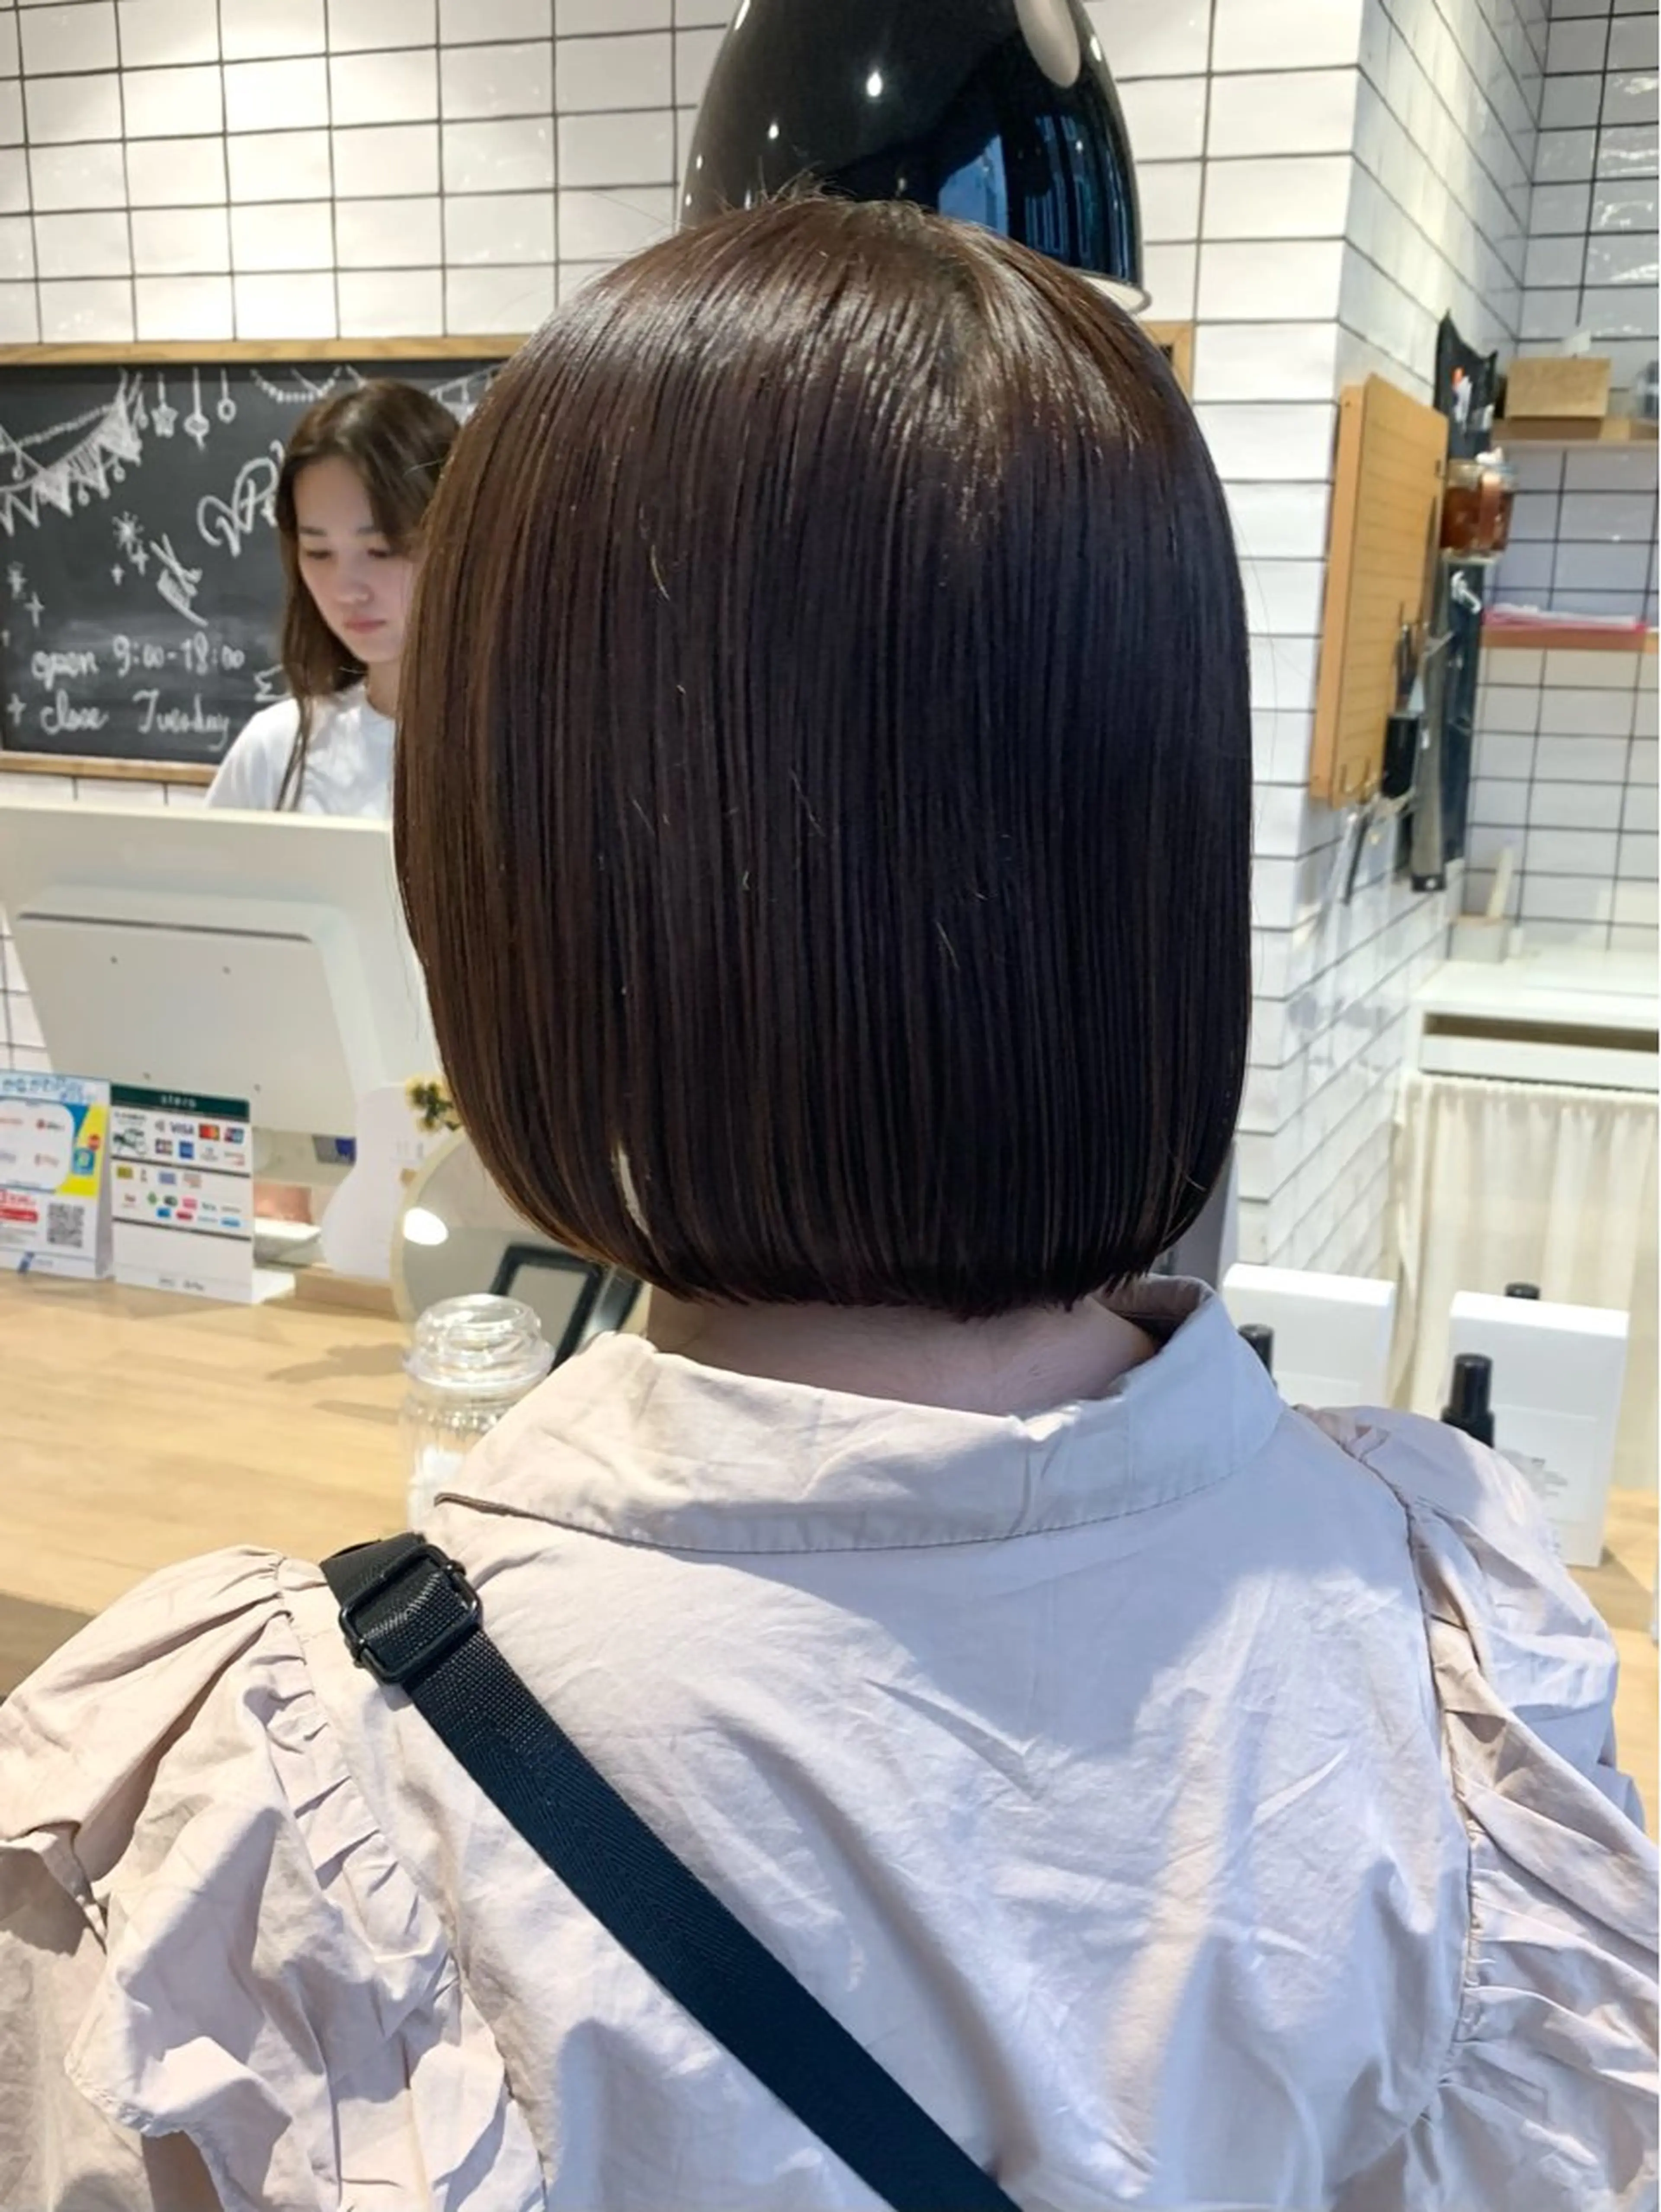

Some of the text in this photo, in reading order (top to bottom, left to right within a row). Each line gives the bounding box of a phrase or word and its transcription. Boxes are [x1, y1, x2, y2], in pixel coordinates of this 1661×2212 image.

[32, 651, 98, 689] open
[41, 689, 229, 751] close Tuesday
